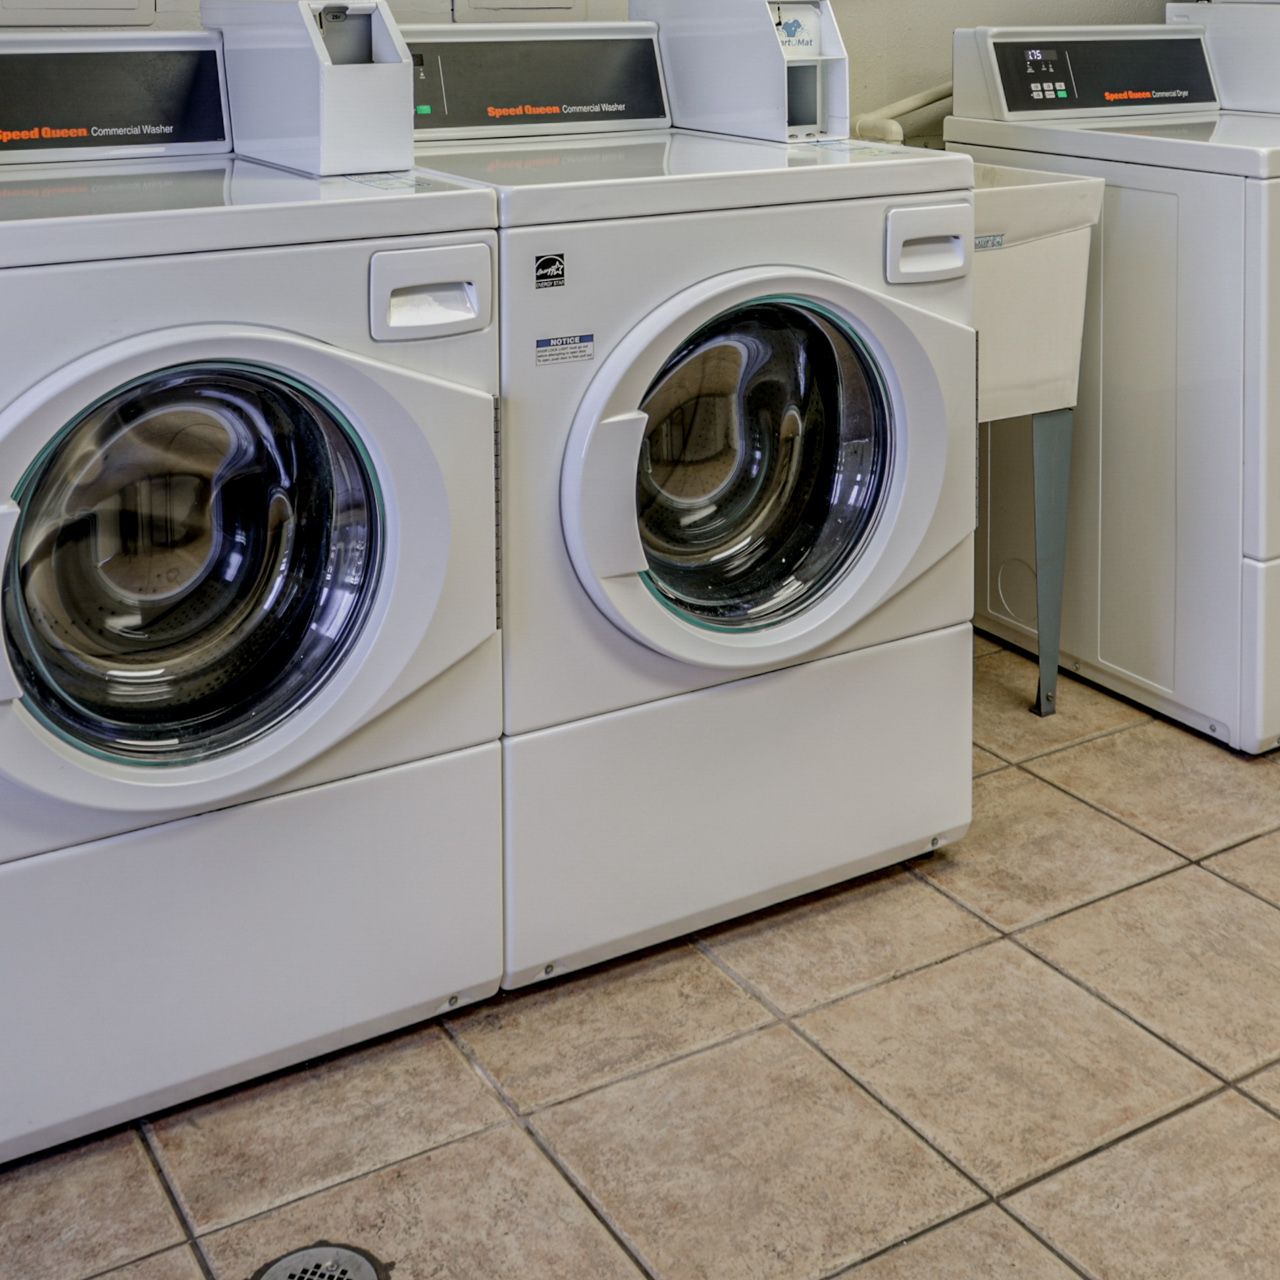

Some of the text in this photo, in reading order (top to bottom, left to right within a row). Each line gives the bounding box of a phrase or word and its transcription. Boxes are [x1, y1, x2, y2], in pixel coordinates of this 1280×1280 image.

[486, 102, 626, 119] Speed Queen Commercial Washer
[41, 126, 88, 138] Queen
[90, 125, 141, 136] Commercial
[142, 124, 174, 135] Washer
[550, 336, 580, 347] NOTICE
